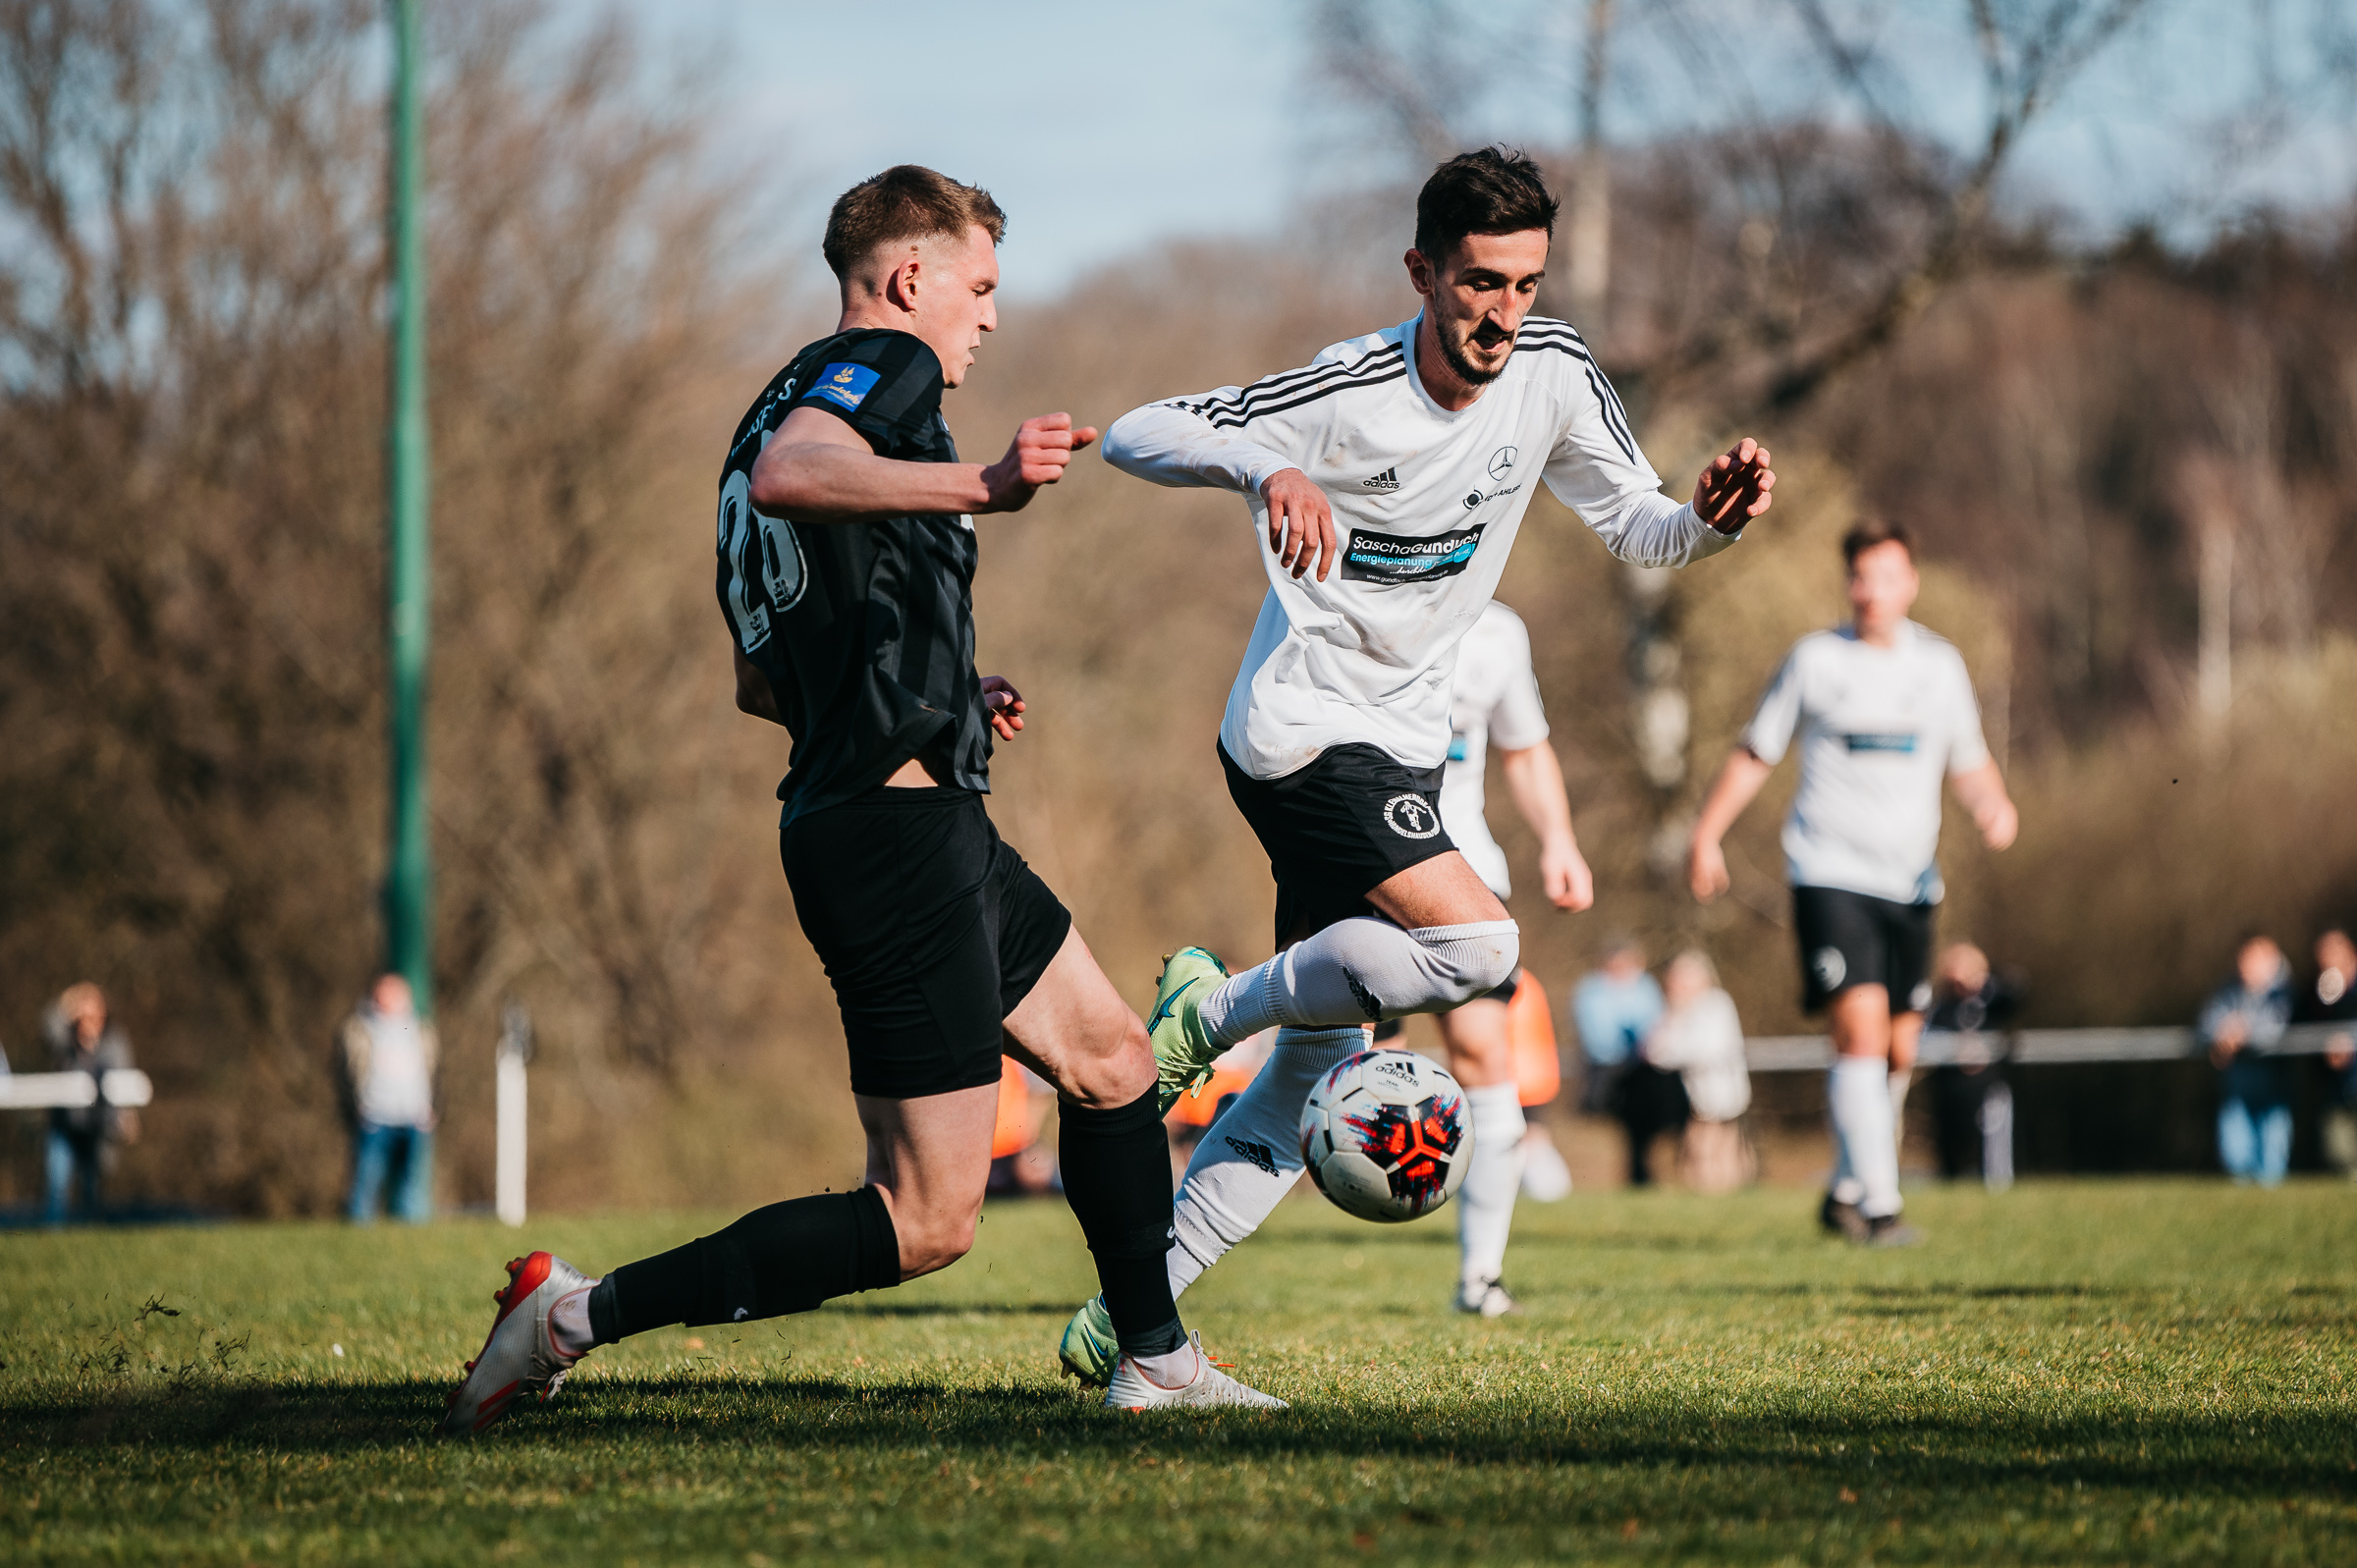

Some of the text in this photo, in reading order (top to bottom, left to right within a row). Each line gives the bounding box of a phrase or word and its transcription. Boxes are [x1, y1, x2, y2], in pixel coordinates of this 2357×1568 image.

[1362, 479, 1400, 490] adidas
[1349, 553, 1434, 568] Energieplanung
[1343, 965, 1384, 1022] adidas
[1375, 1066, 1420, 1087] adidas
[1225, 1136, 1281, 1177] adidas
